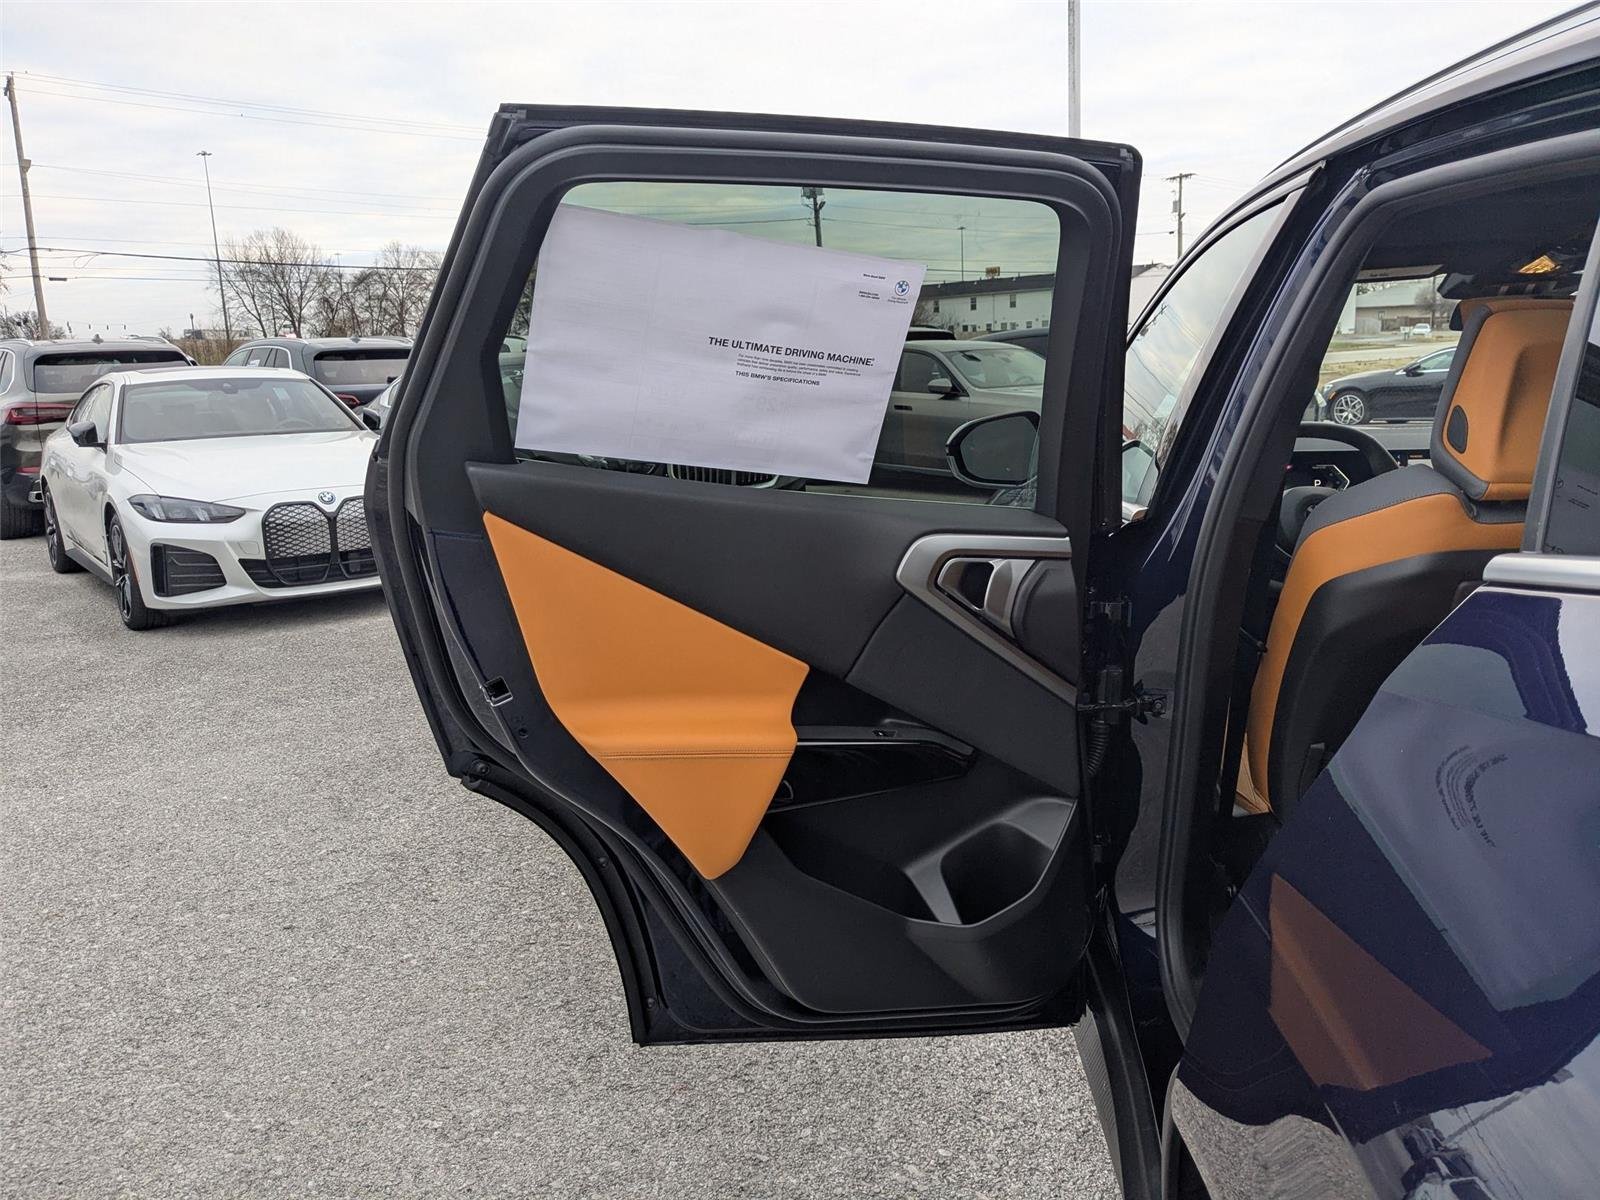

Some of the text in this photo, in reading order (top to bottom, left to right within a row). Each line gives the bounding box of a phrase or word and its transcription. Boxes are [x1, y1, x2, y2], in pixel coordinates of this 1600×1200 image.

[708, 336, 730, 347] THE
[732, 340, 783, 355] ULTIMATE
[784, 348, 825, 360] DRIVING
[750, 373, 772, 381] BMW'S
[772, 376, 820, 386] SPECIFICATIONS
[1314, 479, 1322, 487] P
